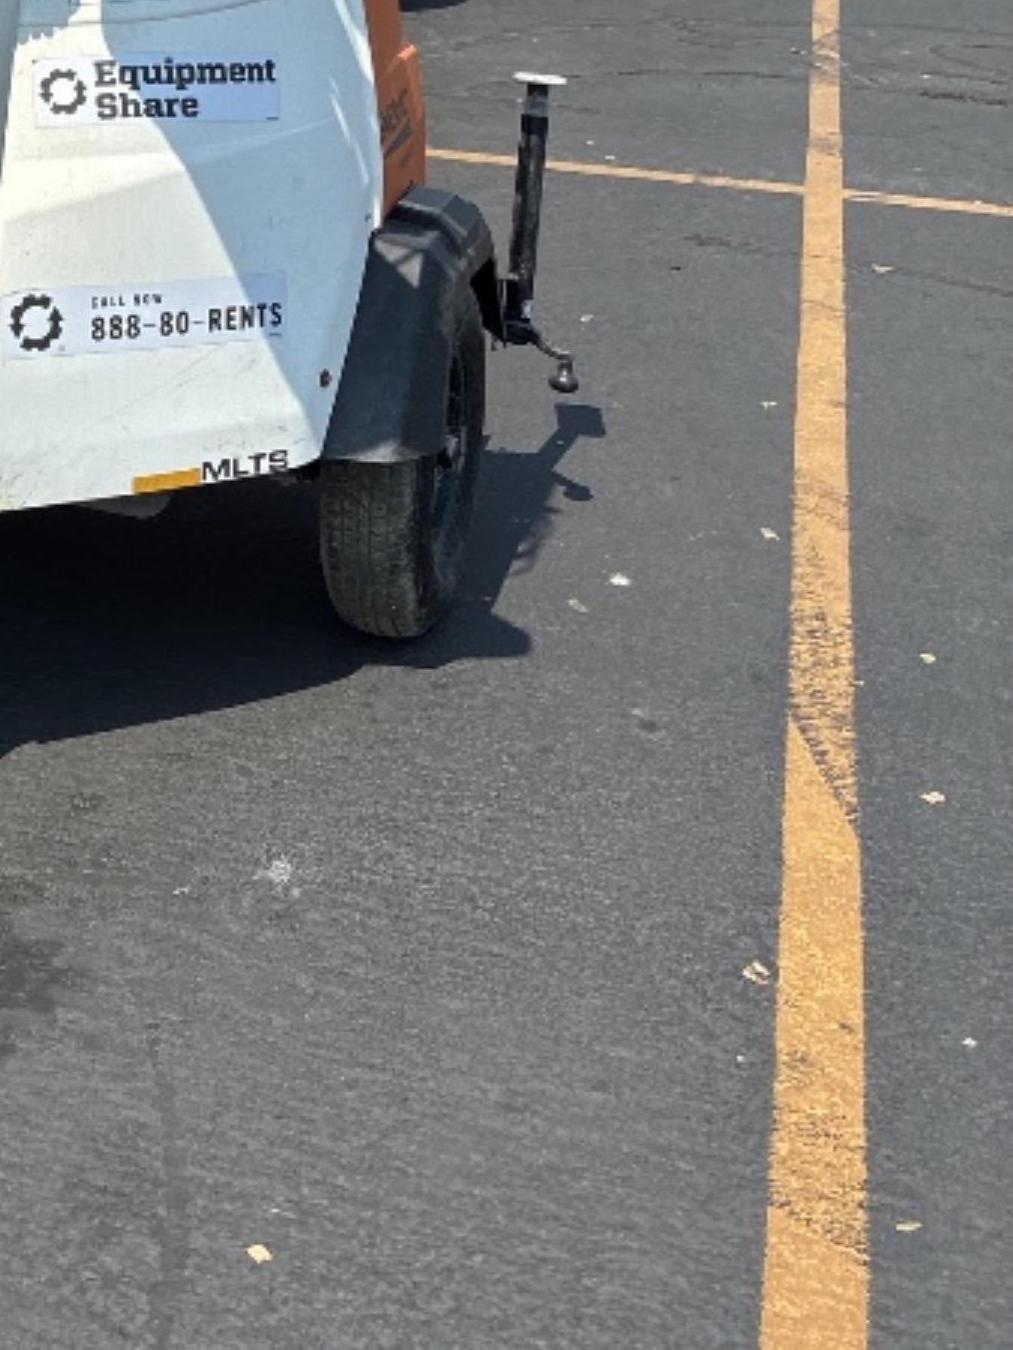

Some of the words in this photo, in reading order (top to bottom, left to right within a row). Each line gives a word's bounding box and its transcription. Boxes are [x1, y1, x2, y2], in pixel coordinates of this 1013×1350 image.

[94, 57, 276, 90] Equipment
[95, 93, 199, 120] Share
[91, 302, 282, 340] 888-80-RENTS
[202, 450, 288, 480] MLTS
